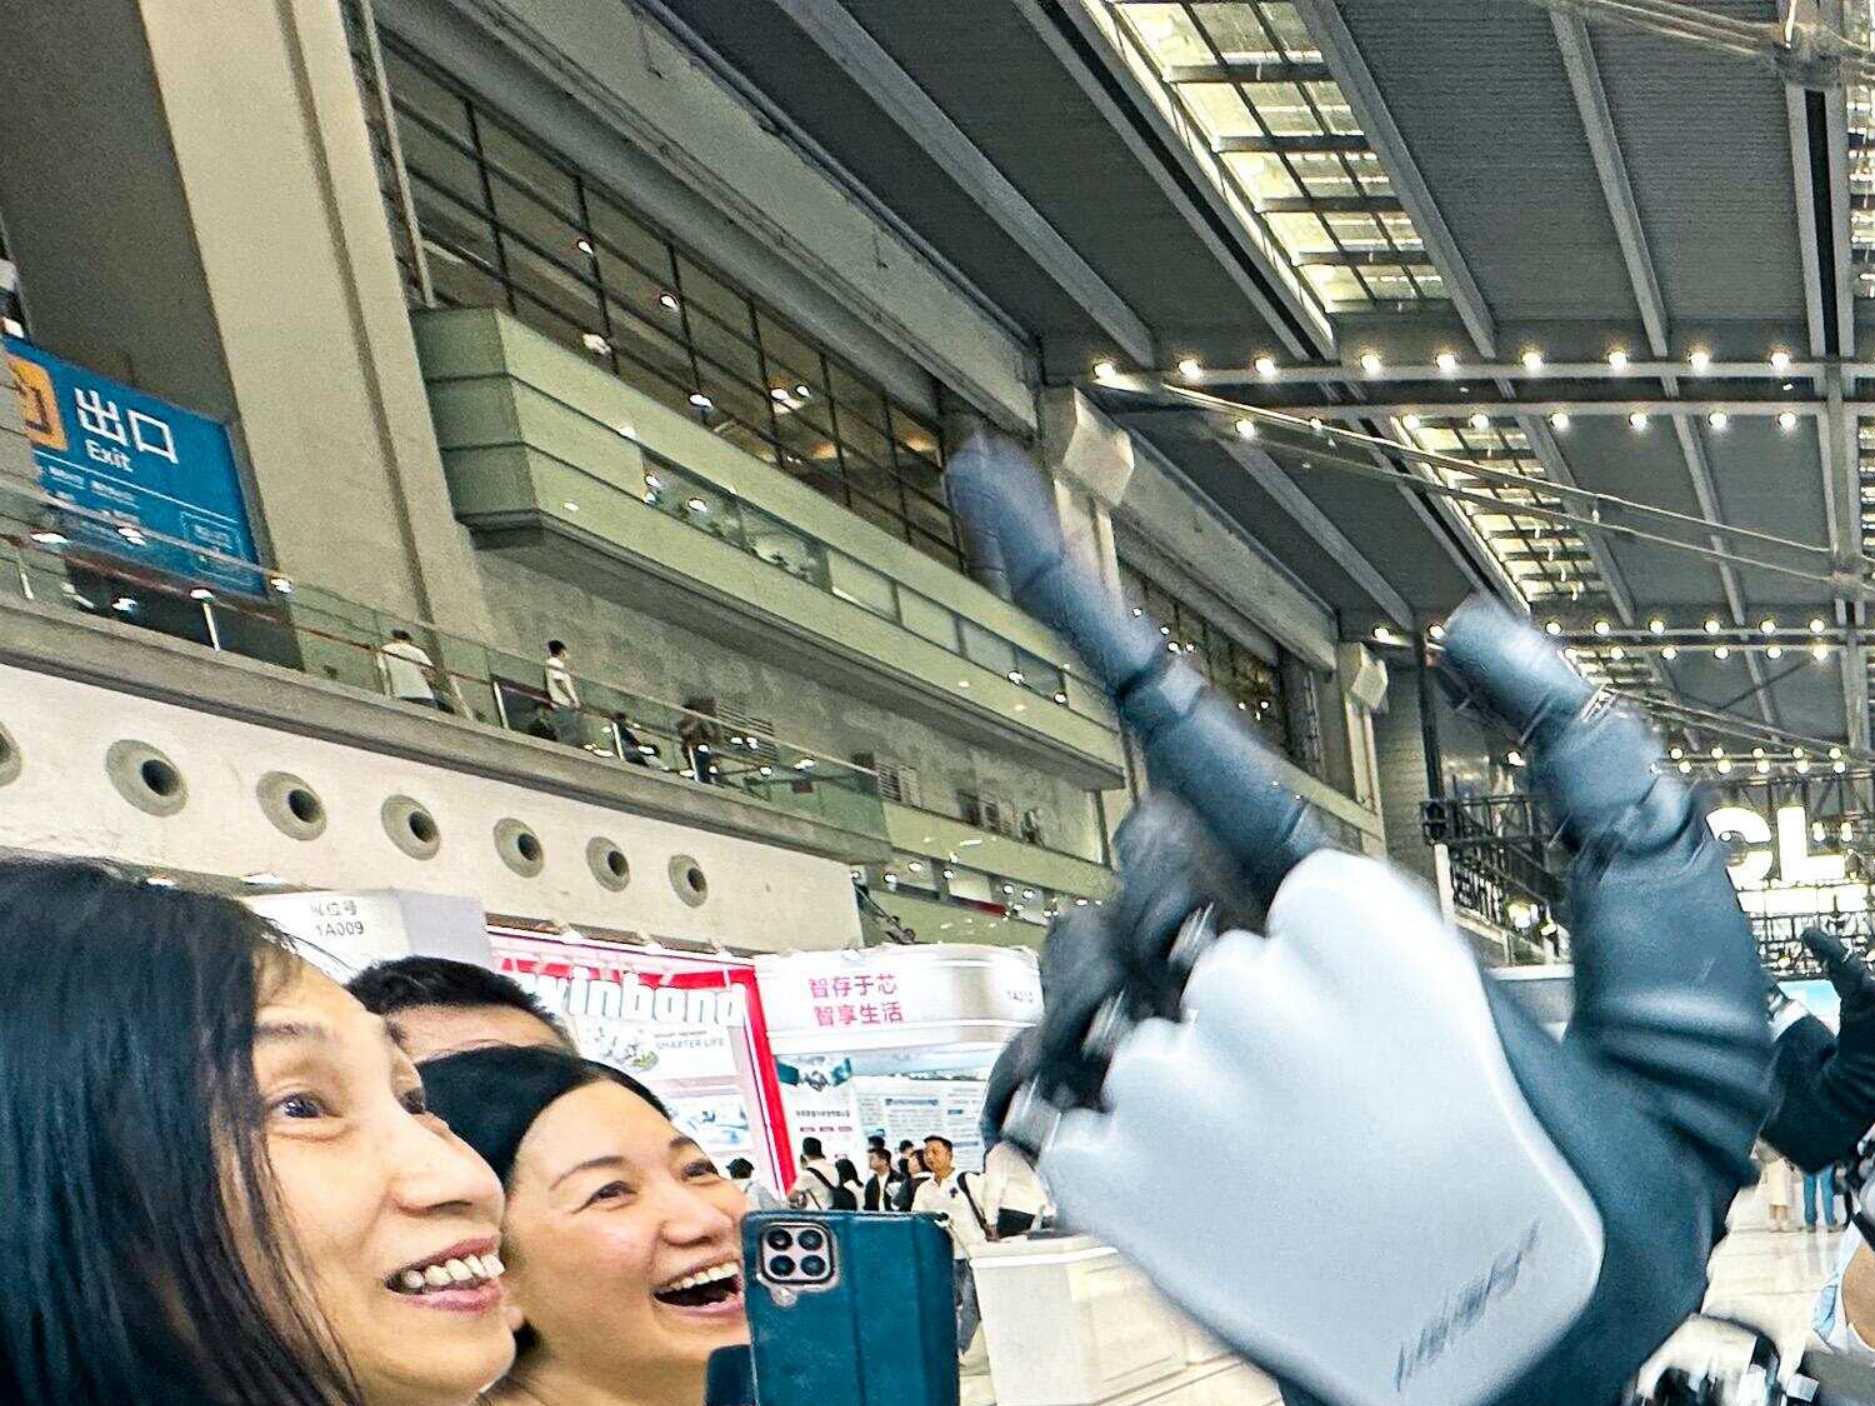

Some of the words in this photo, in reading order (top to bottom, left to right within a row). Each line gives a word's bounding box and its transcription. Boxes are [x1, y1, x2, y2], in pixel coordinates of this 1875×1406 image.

[74, 387, 179, 464] 出口
[85, 438, 133, 473] Exit
[809, 973, 897, 999] 智存于芯
[814, 1001, 904, 1027] 智享生活
